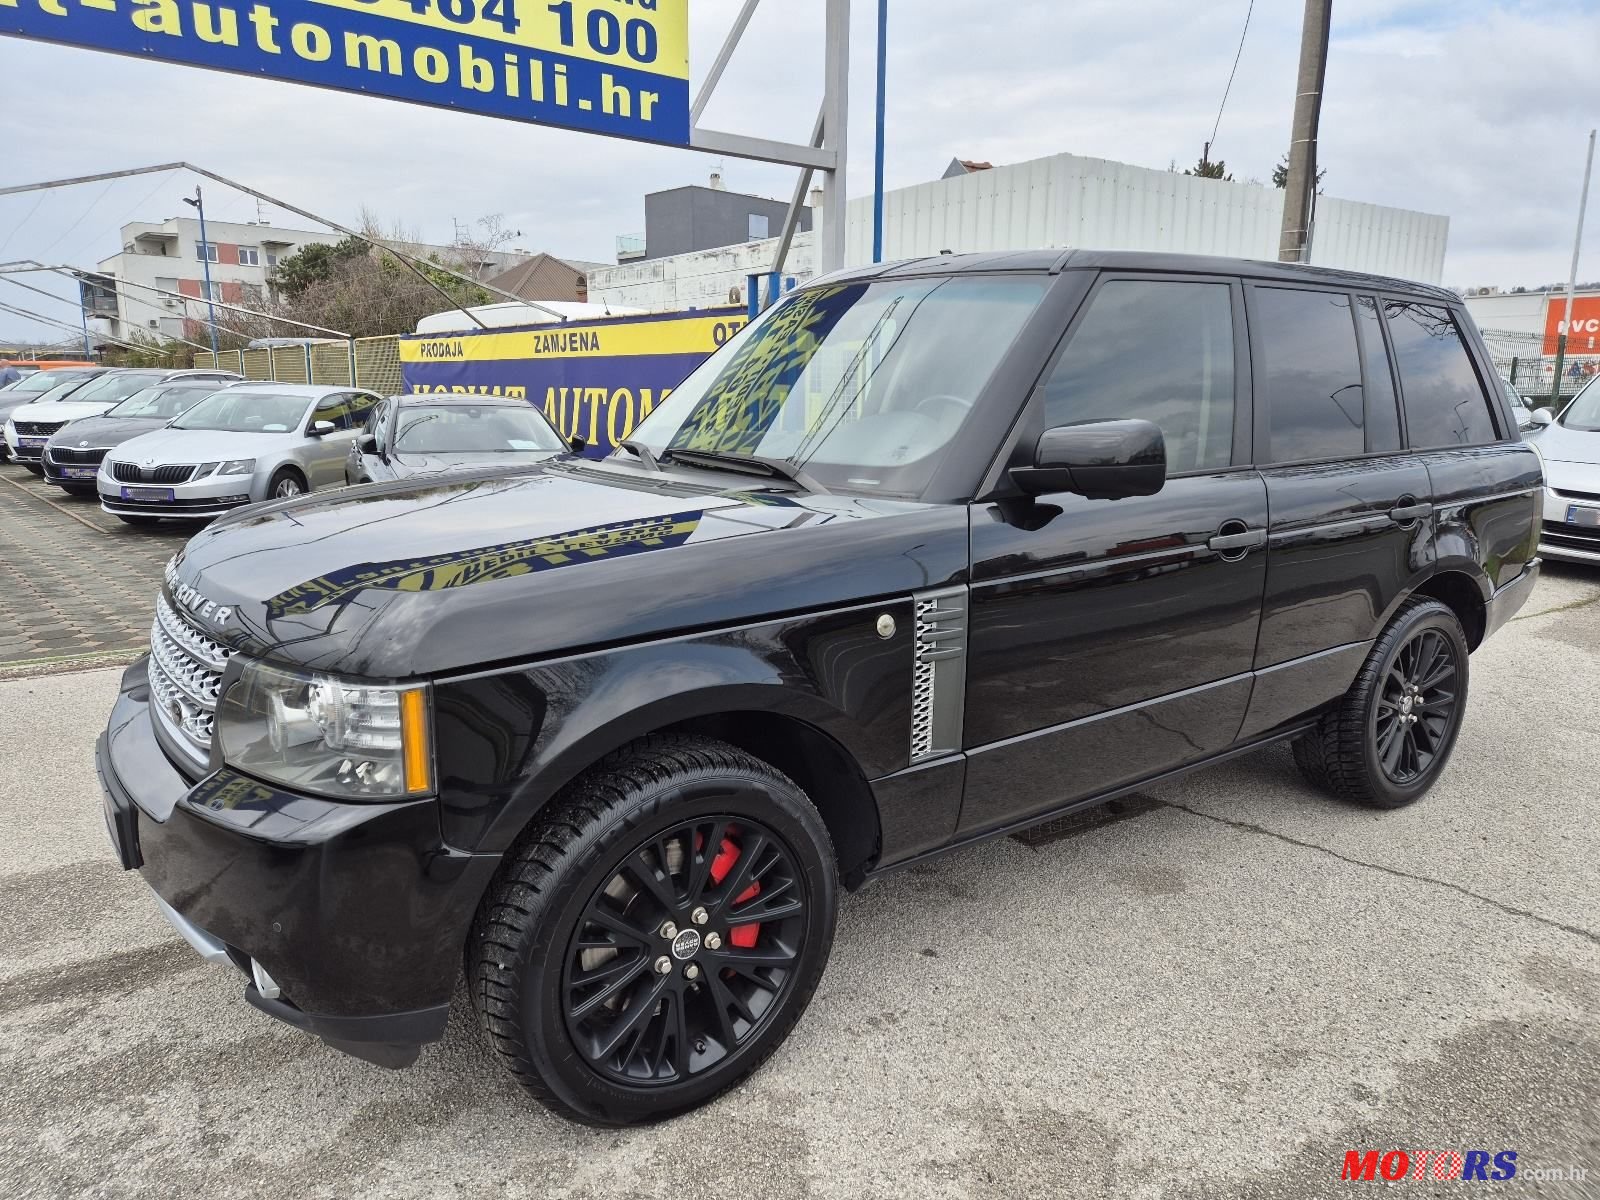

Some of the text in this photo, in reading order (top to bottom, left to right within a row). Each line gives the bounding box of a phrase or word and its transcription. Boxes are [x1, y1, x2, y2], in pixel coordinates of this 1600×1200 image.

[548, 1, 658, 64] 100
[420, 341, 464, 358] PRODAJA
[533, 331, 600, 354] ZAMJENA
[175, 583, 232, 625] ROVER
